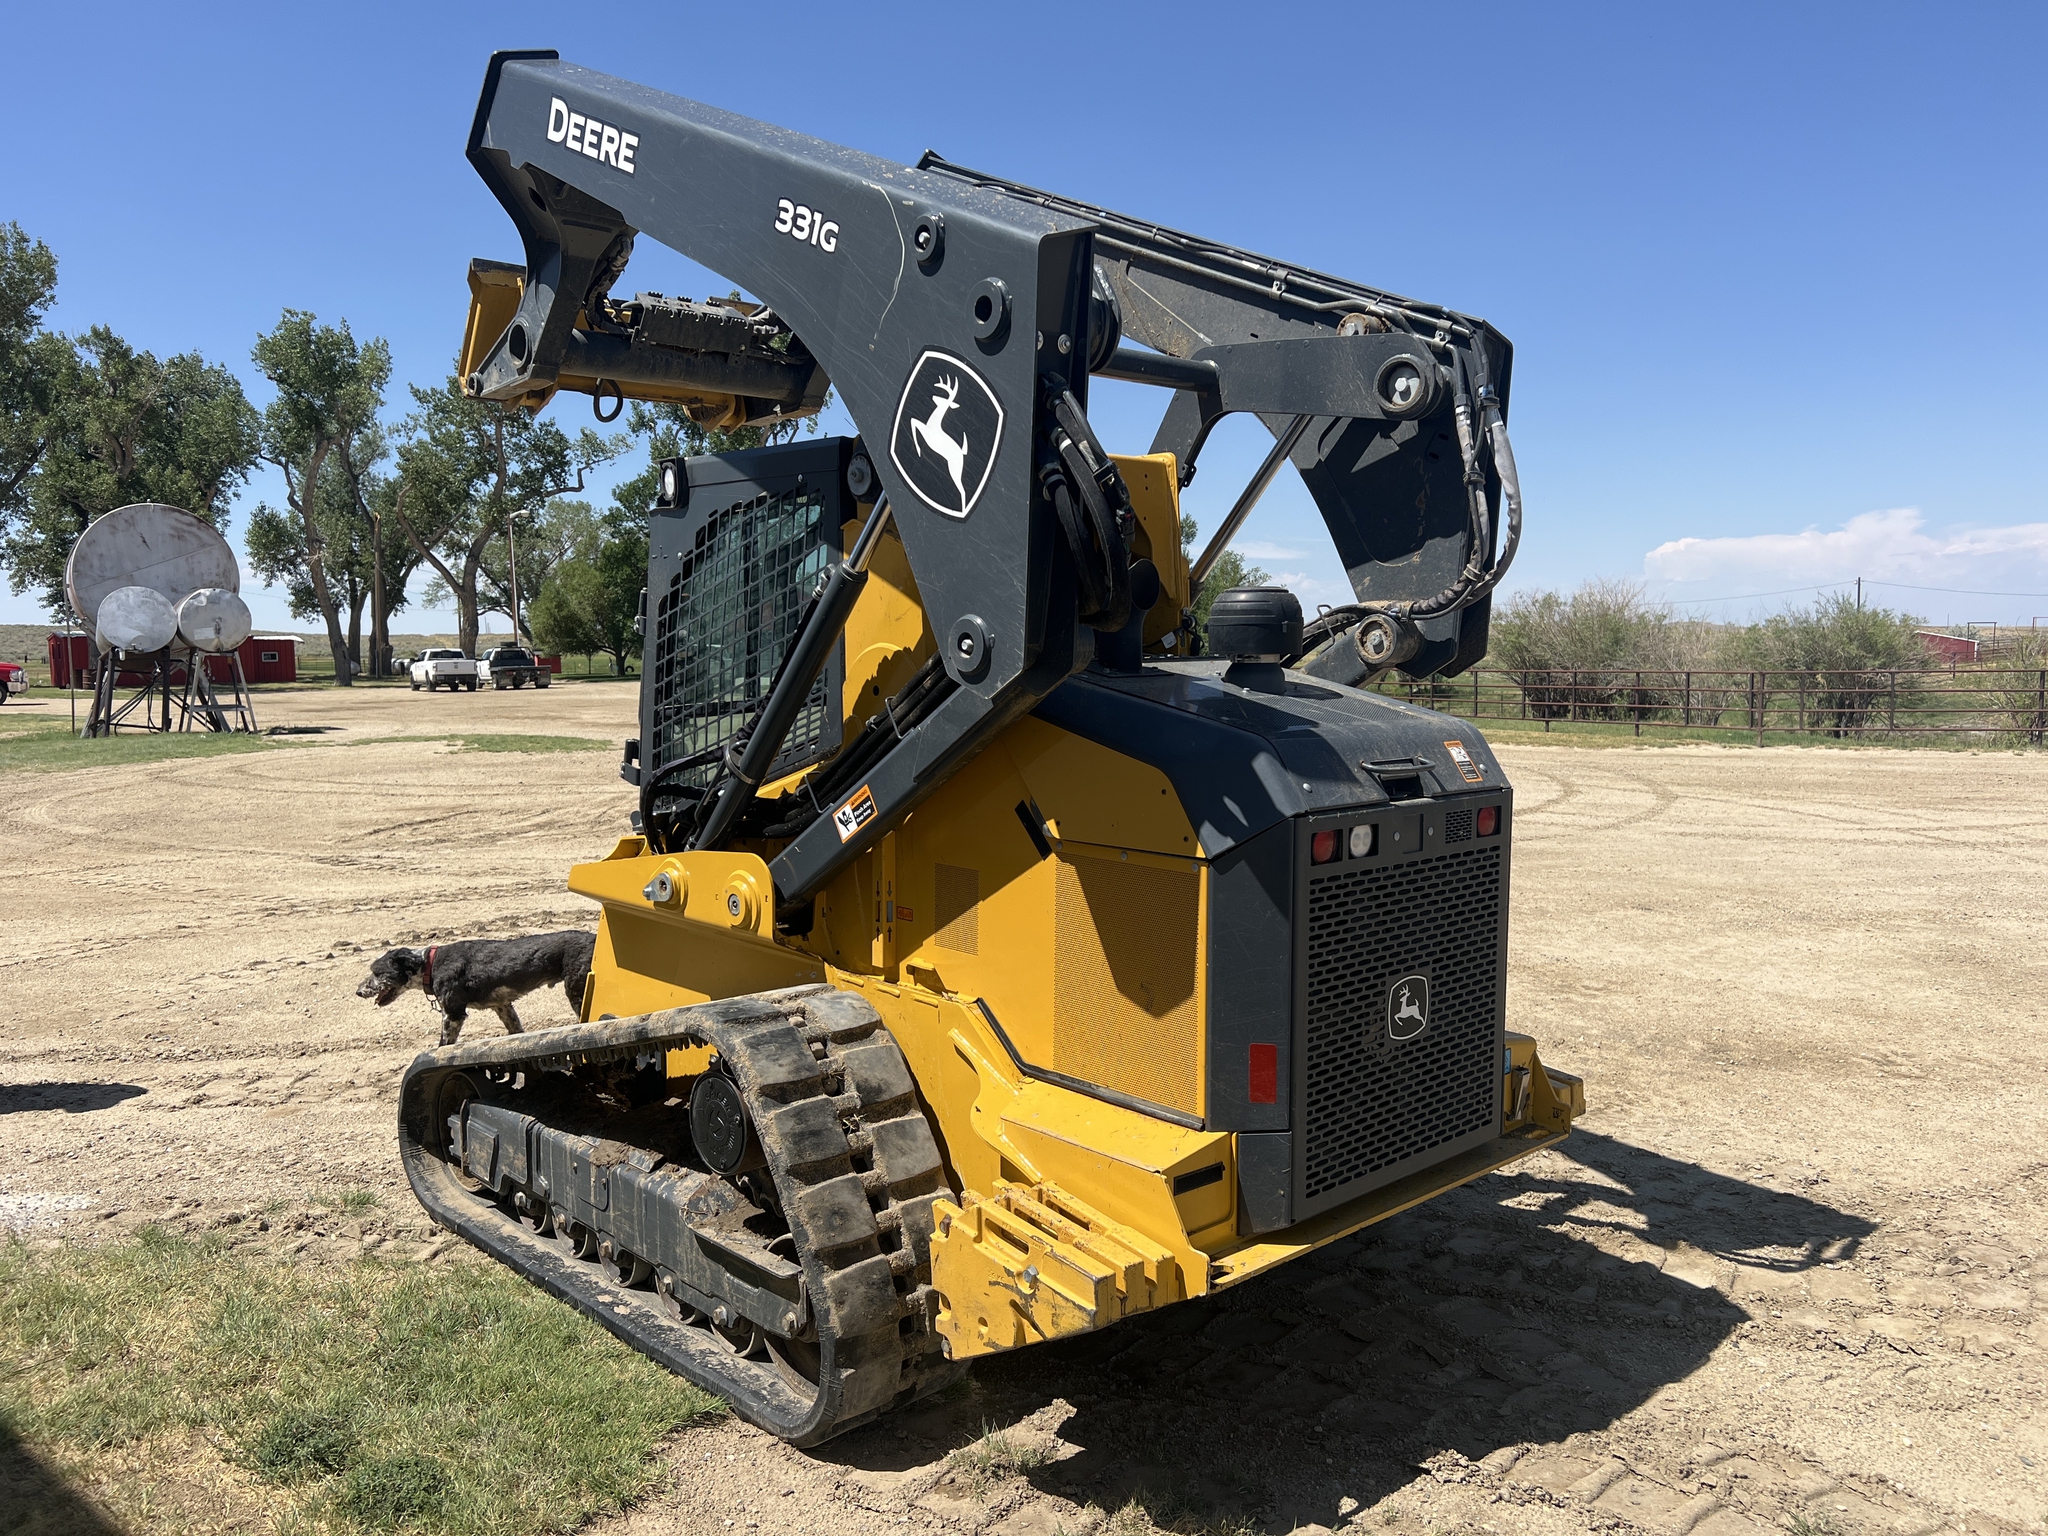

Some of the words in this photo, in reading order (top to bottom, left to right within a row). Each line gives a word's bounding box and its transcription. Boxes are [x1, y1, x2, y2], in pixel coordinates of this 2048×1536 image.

[547, 97, 639, 174] DEERE
[774, 198, 840, 253] 331G
[854, 806, 864, 817] Pinch
[863, 800, 871, 810] Area
